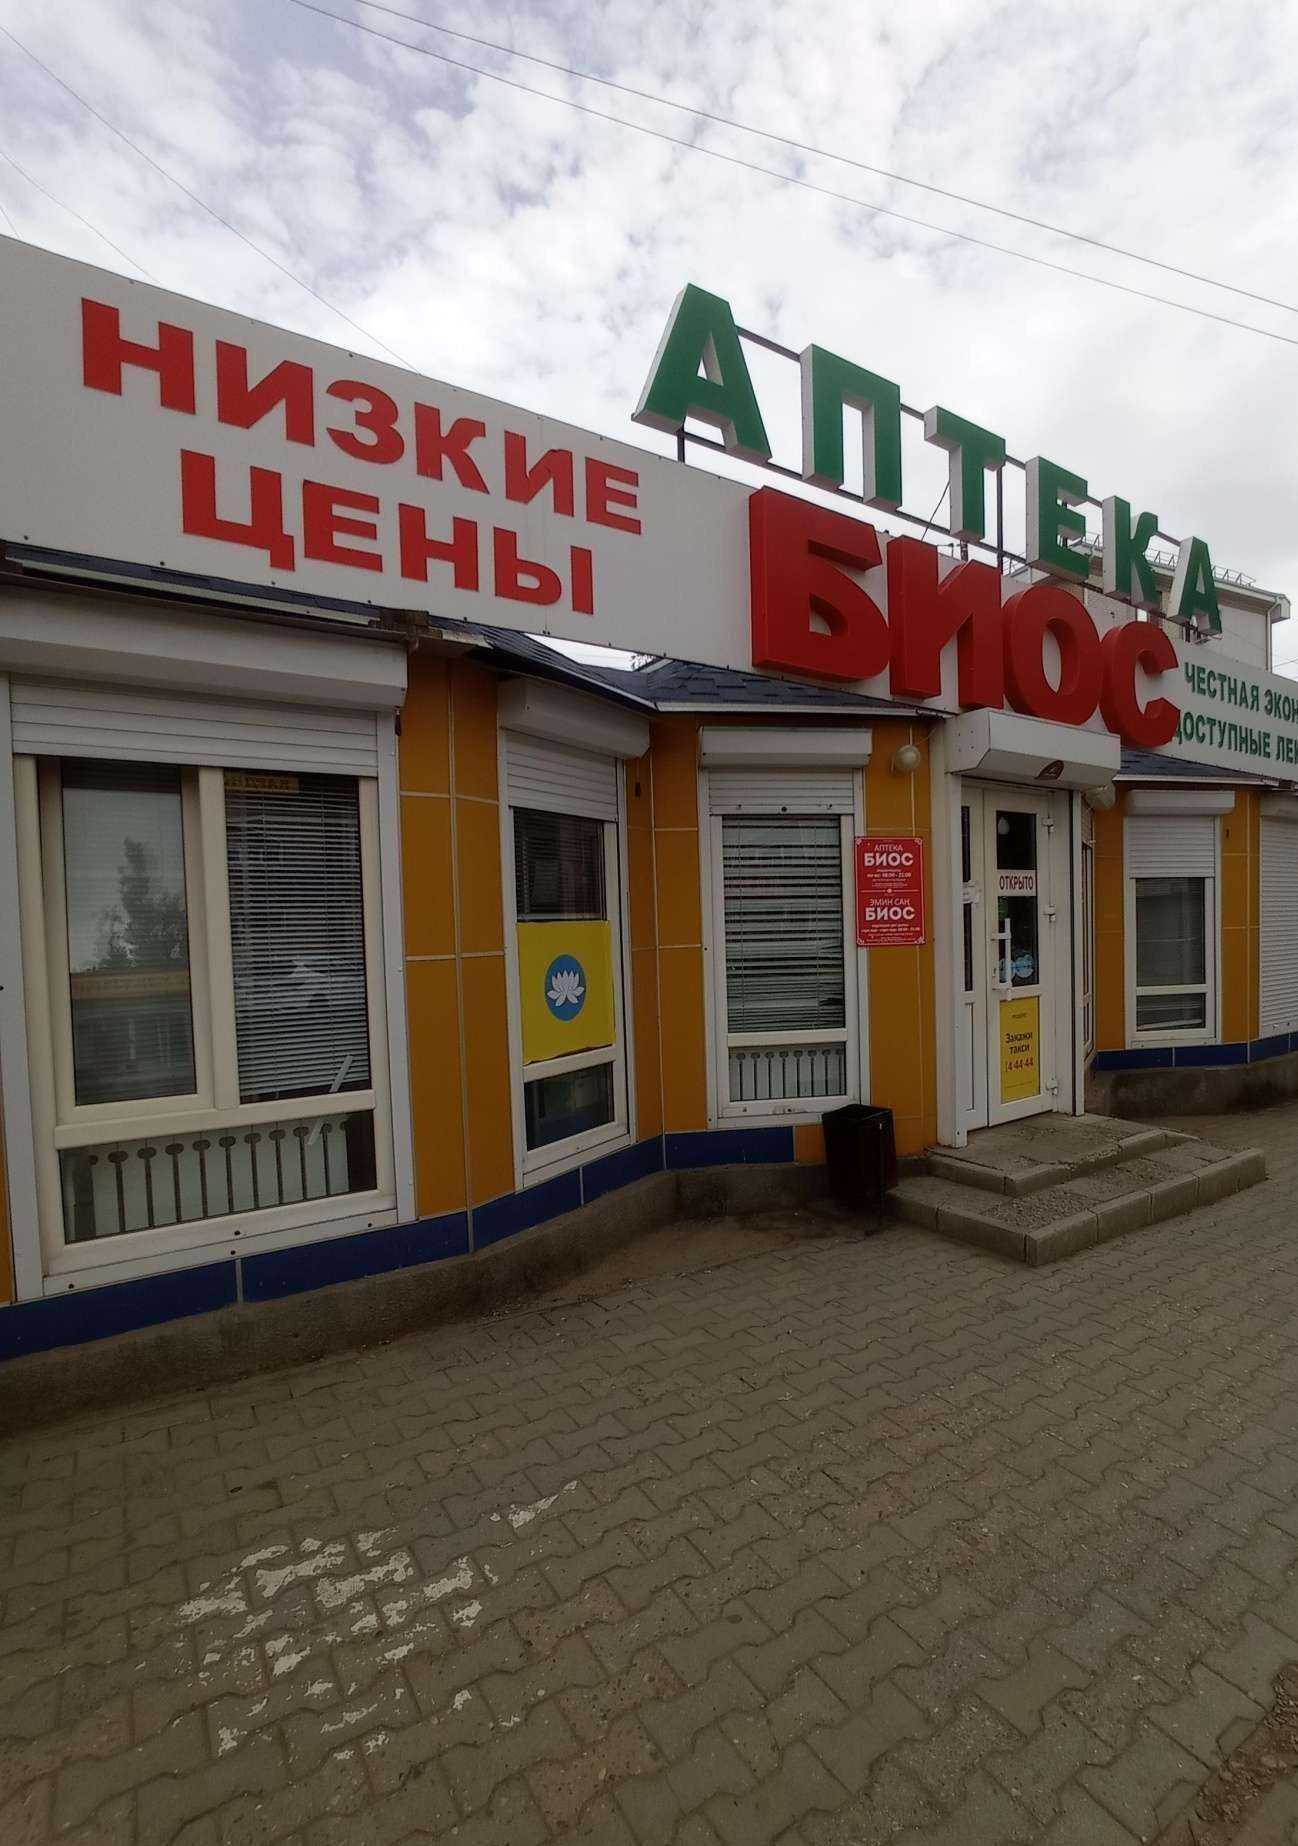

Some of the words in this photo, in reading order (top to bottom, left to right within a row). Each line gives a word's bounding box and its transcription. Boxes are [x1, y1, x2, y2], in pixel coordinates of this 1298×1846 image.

[81, 297, 642, 535] НИЗКИЕ
[632, 283, 1222, 636] АПТЕКА
[181, 449, 594, 615] ЦЕНЫ
[749, 486, 1181, 748] БИОС
[1184, 661, 1260, 712] ЧЕСТНАЯ
[864, 852, 914, 867] БИОС
[874, 843, 904, 852] АПТЕКА
[999, 875, 1034, 890] ОТКРЫТО
[865, 906, 916, 921] БИОС
